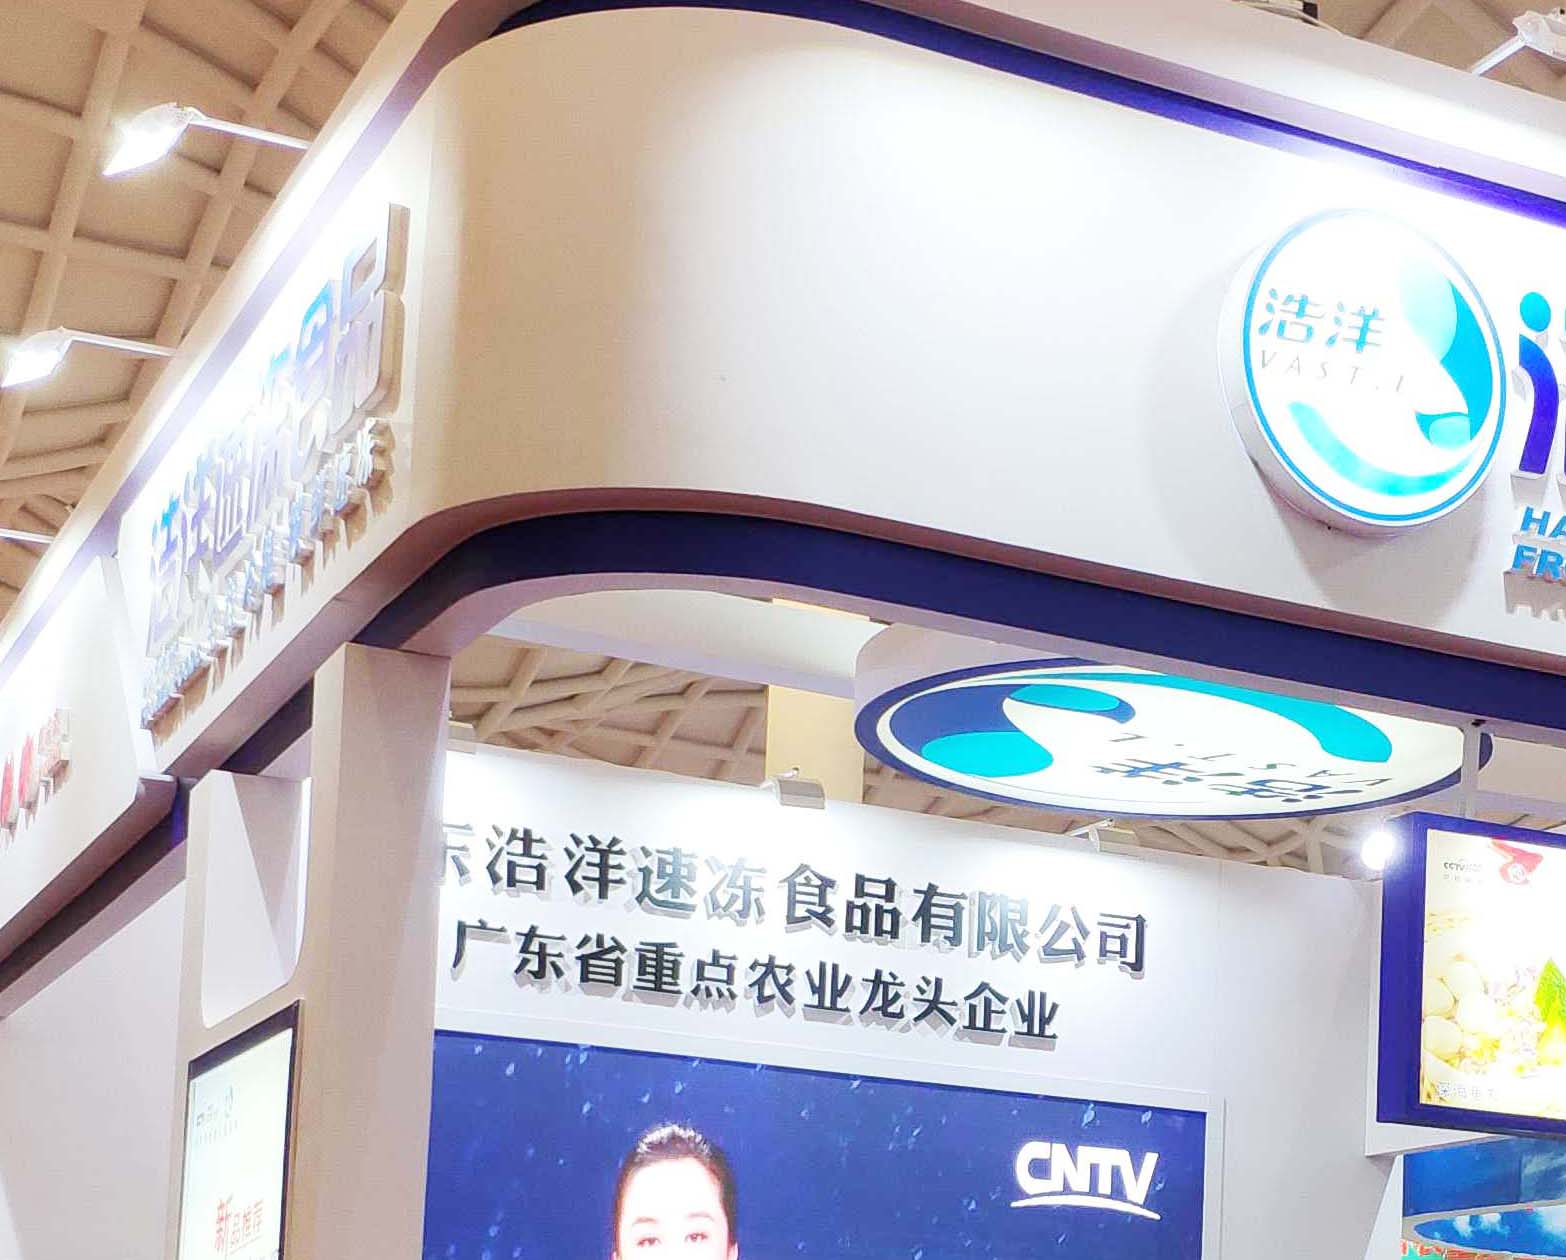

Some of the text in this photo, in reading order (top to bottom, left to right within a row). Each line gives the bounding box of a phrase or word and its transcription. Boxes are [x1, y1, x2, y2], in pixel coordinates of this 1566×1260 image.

[1258, 287, 1386, 353] 浩洋
[451, 918, 1061, 1041] 广东省重点农业龙头企业
[1016, 1140, 1160, 1206] CNTV
